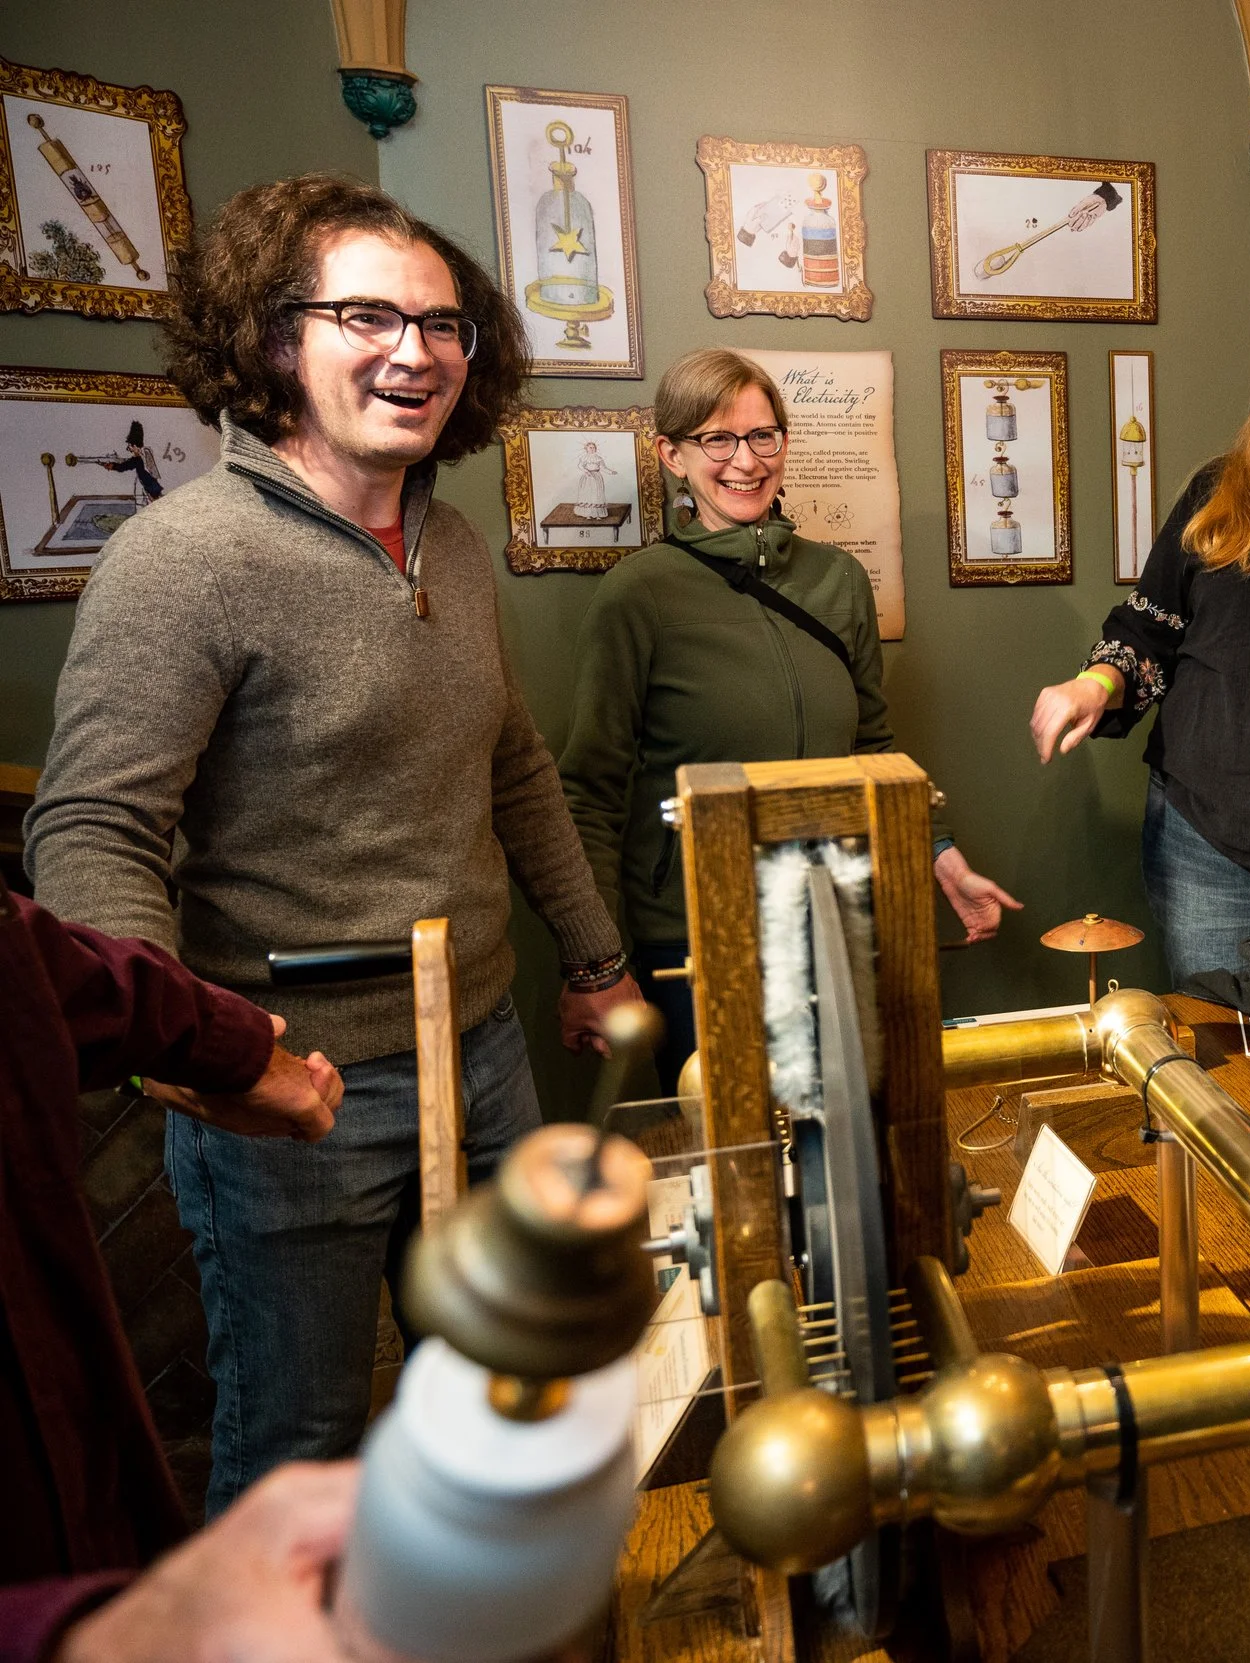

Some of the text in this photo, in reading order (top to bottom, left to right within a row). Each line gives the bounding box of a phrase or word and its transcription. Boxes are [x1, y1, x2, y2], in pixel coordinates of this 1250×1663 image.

[782, 367, 834, 386] What is
[792, 386, 876, 414] Electricity?
